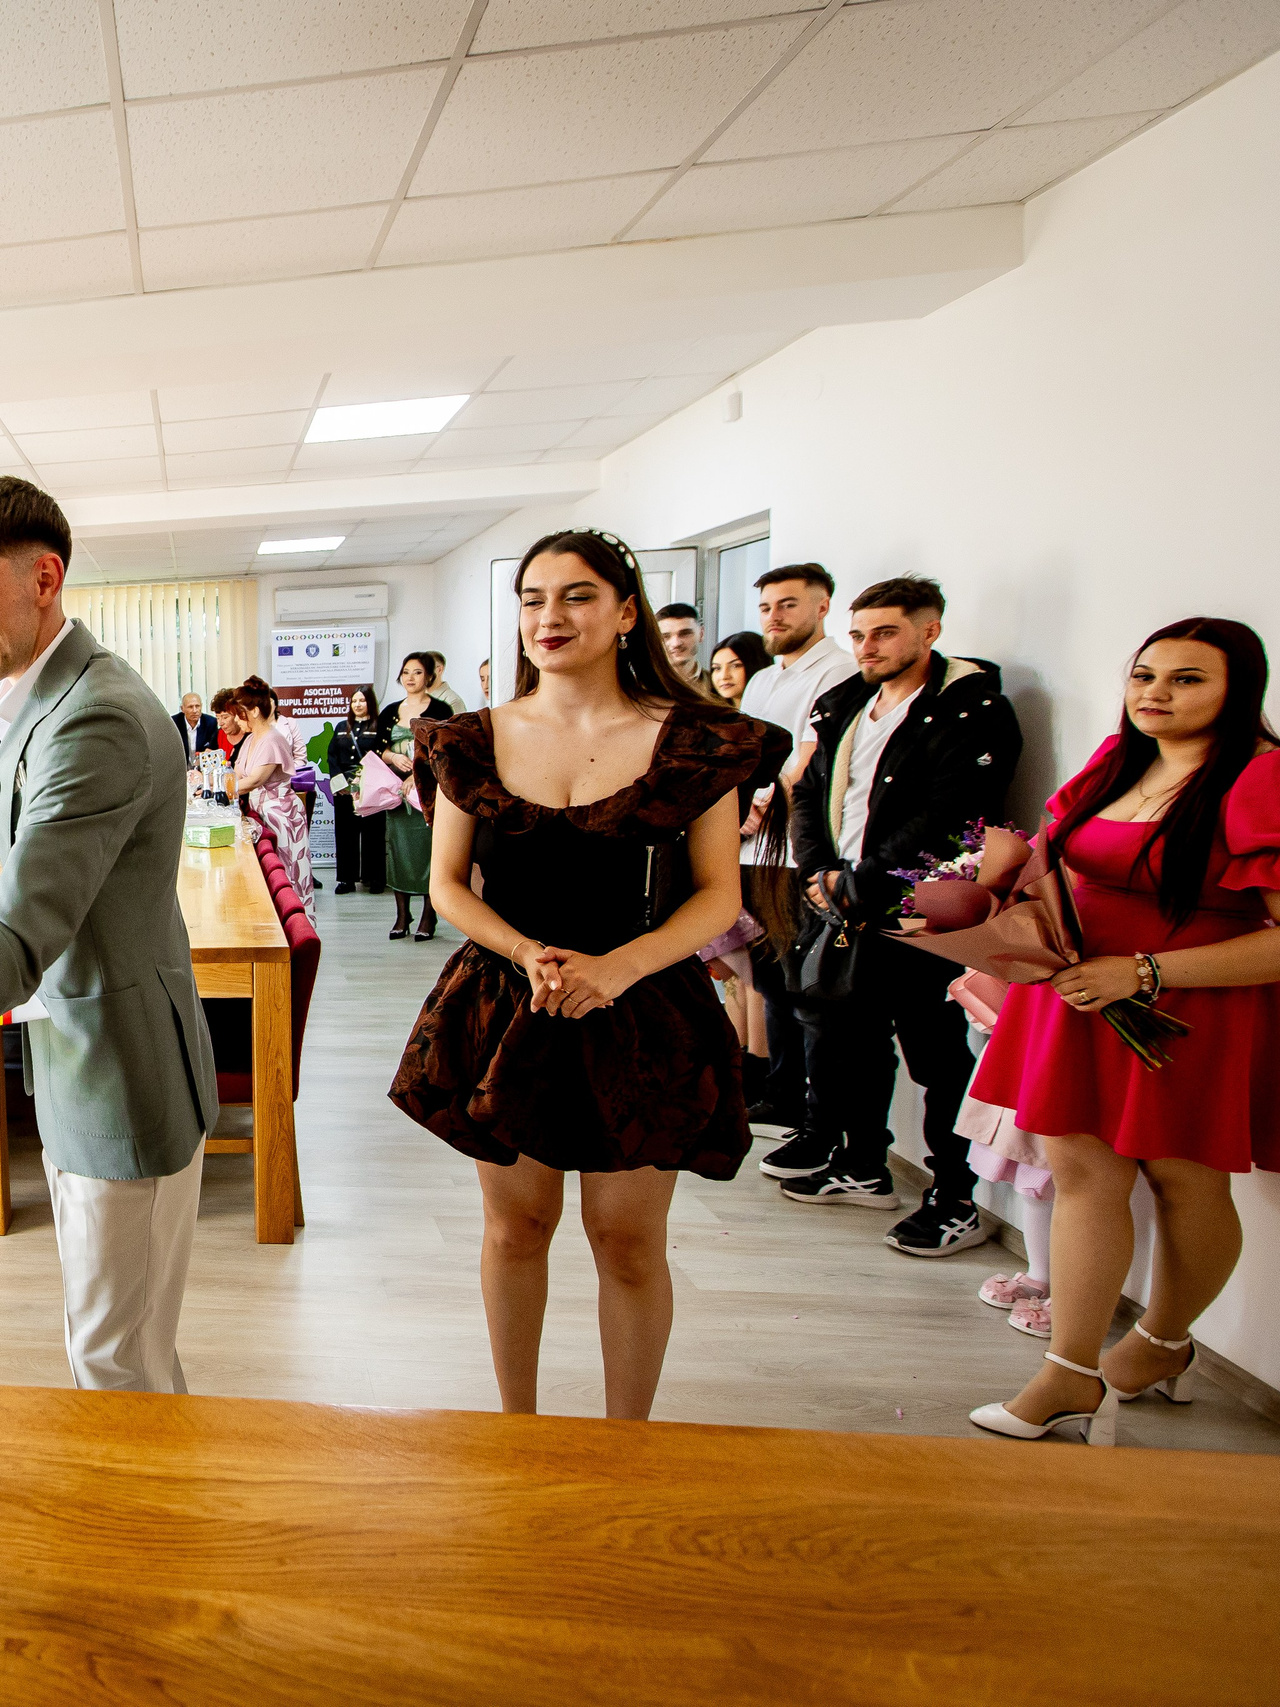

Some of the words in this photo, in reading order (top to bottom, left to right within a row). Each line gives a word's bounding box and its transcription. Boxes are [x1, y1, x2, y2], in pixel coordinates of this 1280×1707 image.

[304, 688, 342, 697] ASOCIAȚIA
[278, 698, 302, 706] RUPUL
[313, 697, 344, 706] ACȚIUNE
[292, 707, 319, 715] POIANA
